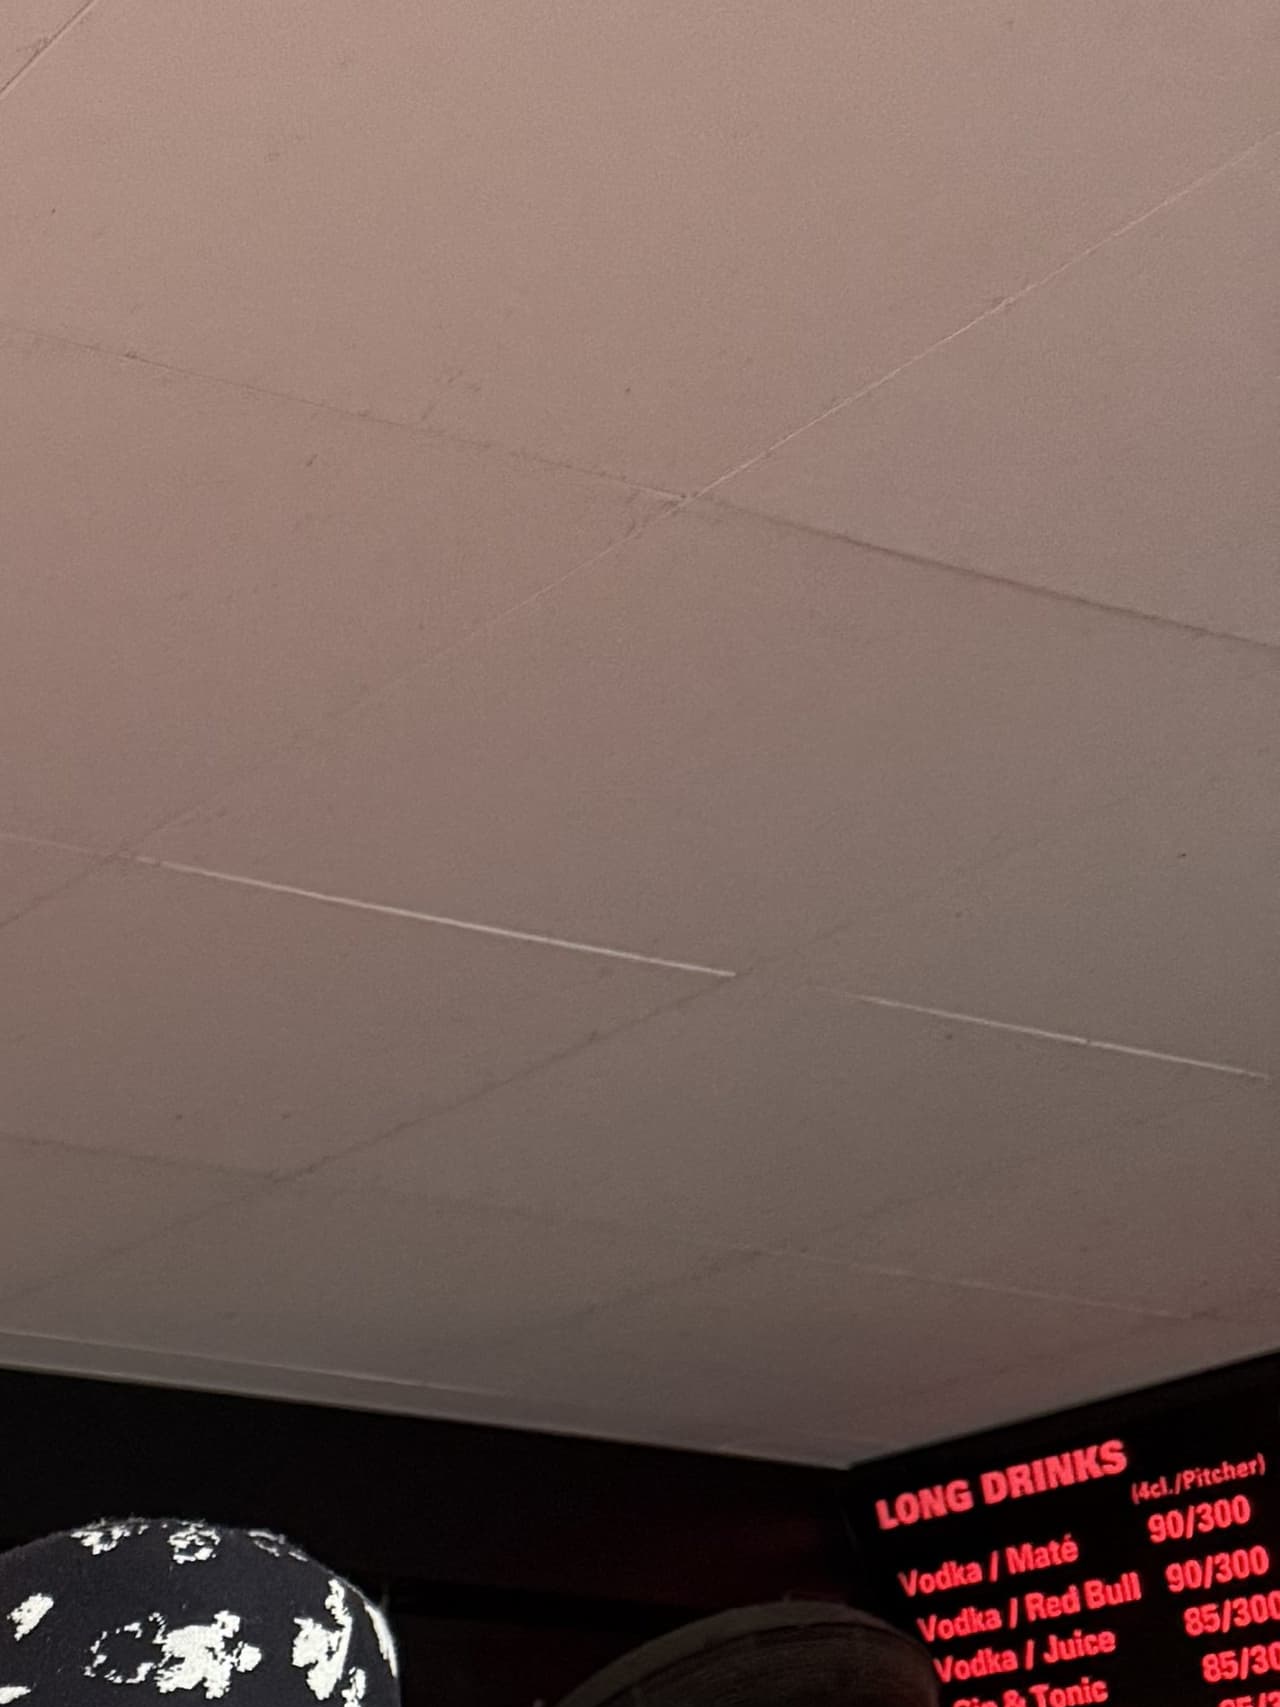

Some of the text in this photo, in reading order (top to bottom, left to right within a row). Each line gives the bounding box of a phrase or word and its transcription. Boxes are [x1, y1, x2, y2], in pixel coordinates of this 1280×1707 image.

[875, 1439, 1128, 1530] LONG DRINKS
[897, 1494, 1252, 1597] Vodka / Maté 90/300
[916, 1545, 1270, 1643] Vodka / Red Bull 90/300
[933, 1648, 1019, 1683] Vodka
[1024, 1639, 1035, 1670] /
[1043, 1629, 1117, 1664] Juice
